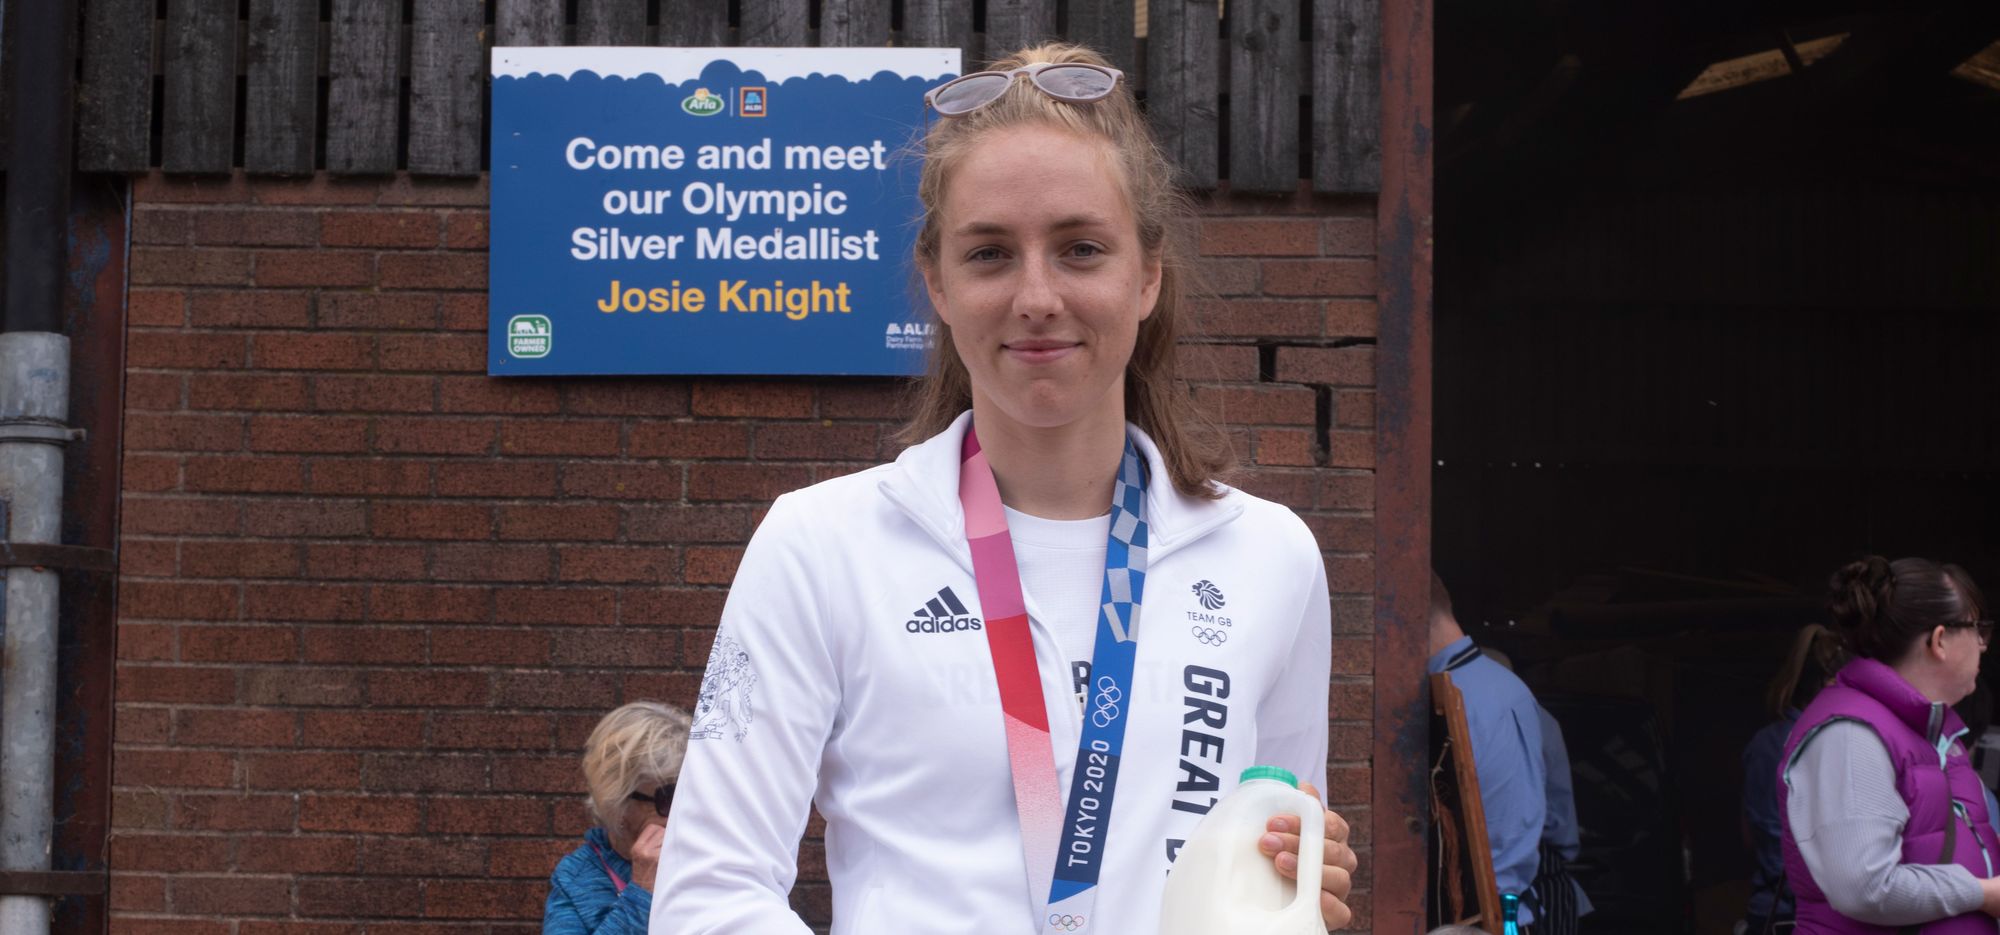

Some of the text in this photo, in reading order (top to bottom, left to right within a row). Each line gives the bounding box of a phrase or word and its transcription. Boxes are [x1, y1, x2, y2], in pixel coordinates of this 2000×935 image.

[689, 98, 717, 110] Arla
[566, 137, 887, 170] Come and meet
[603, 182, 848, 221] our Olympic
[571, 227, 880, 260] Silver Medallist
[598, 280, 851, 320] Josie Knight
[906, 615, 982, 633] adidas
[1187, 611, 1232, 627] TEAM GB
[1068, 740, 1110, 867] TOKYO 2020
